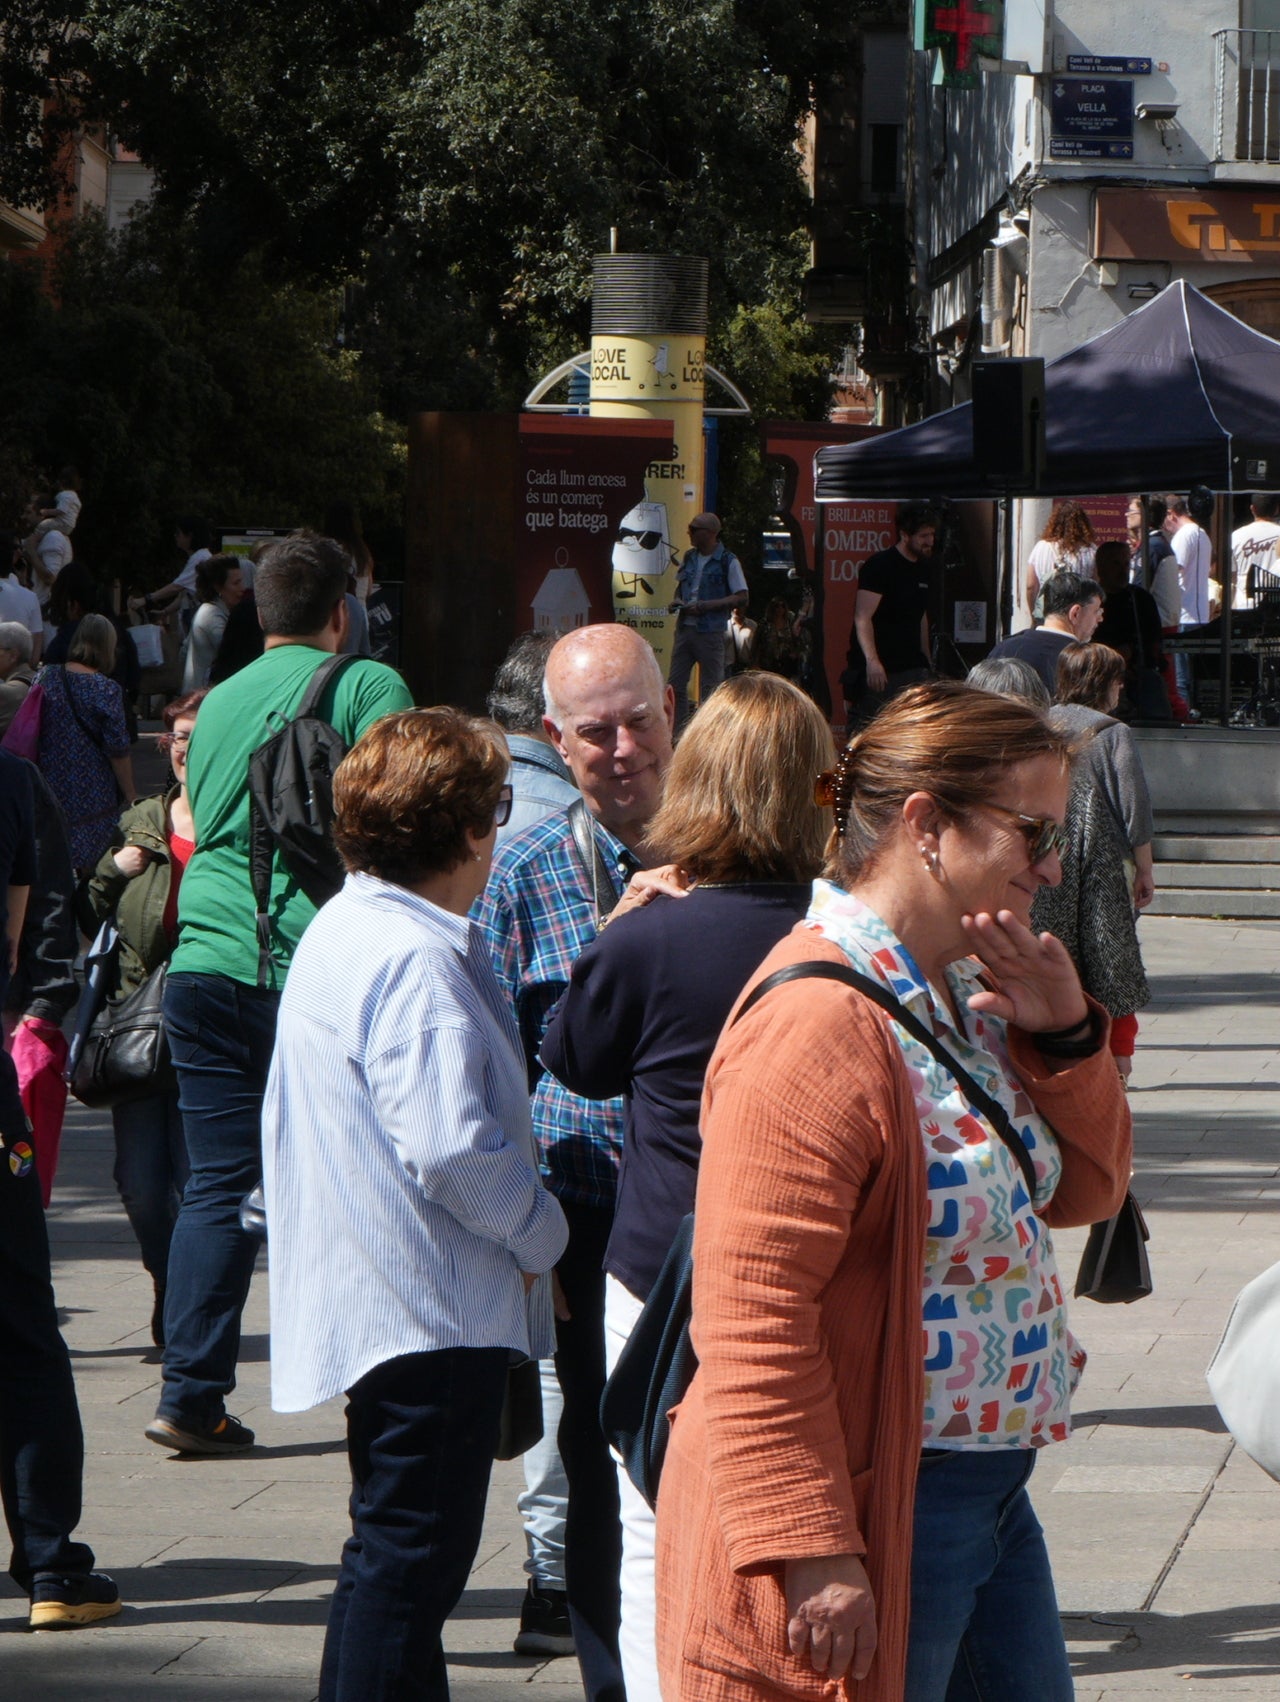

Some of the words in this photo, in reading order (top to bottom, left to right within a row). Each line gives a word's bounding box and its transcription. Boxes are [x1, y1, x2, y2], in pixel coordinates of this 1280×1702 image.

[1078, 103, 1106, 112] VELLA
[593, 348, 626, 364] LOVE
[526, 469, 557, 486] Cada
[560, 470, 585, 486] llum
[588, 474, 626, 487] encesa
[644, 464, 685, 480] RER!
[526, 488, 540, 504] és
[542, 492, 558, 504] un
[560, 492, 604, 509] comerç
[526, 511, 554, 532] que
[558, 508, 608, 534] batega
[828, 508, 875, 523] BRILLAR
[878, 510, 891, 523] EL
[641, 620, 664, 628] mes
